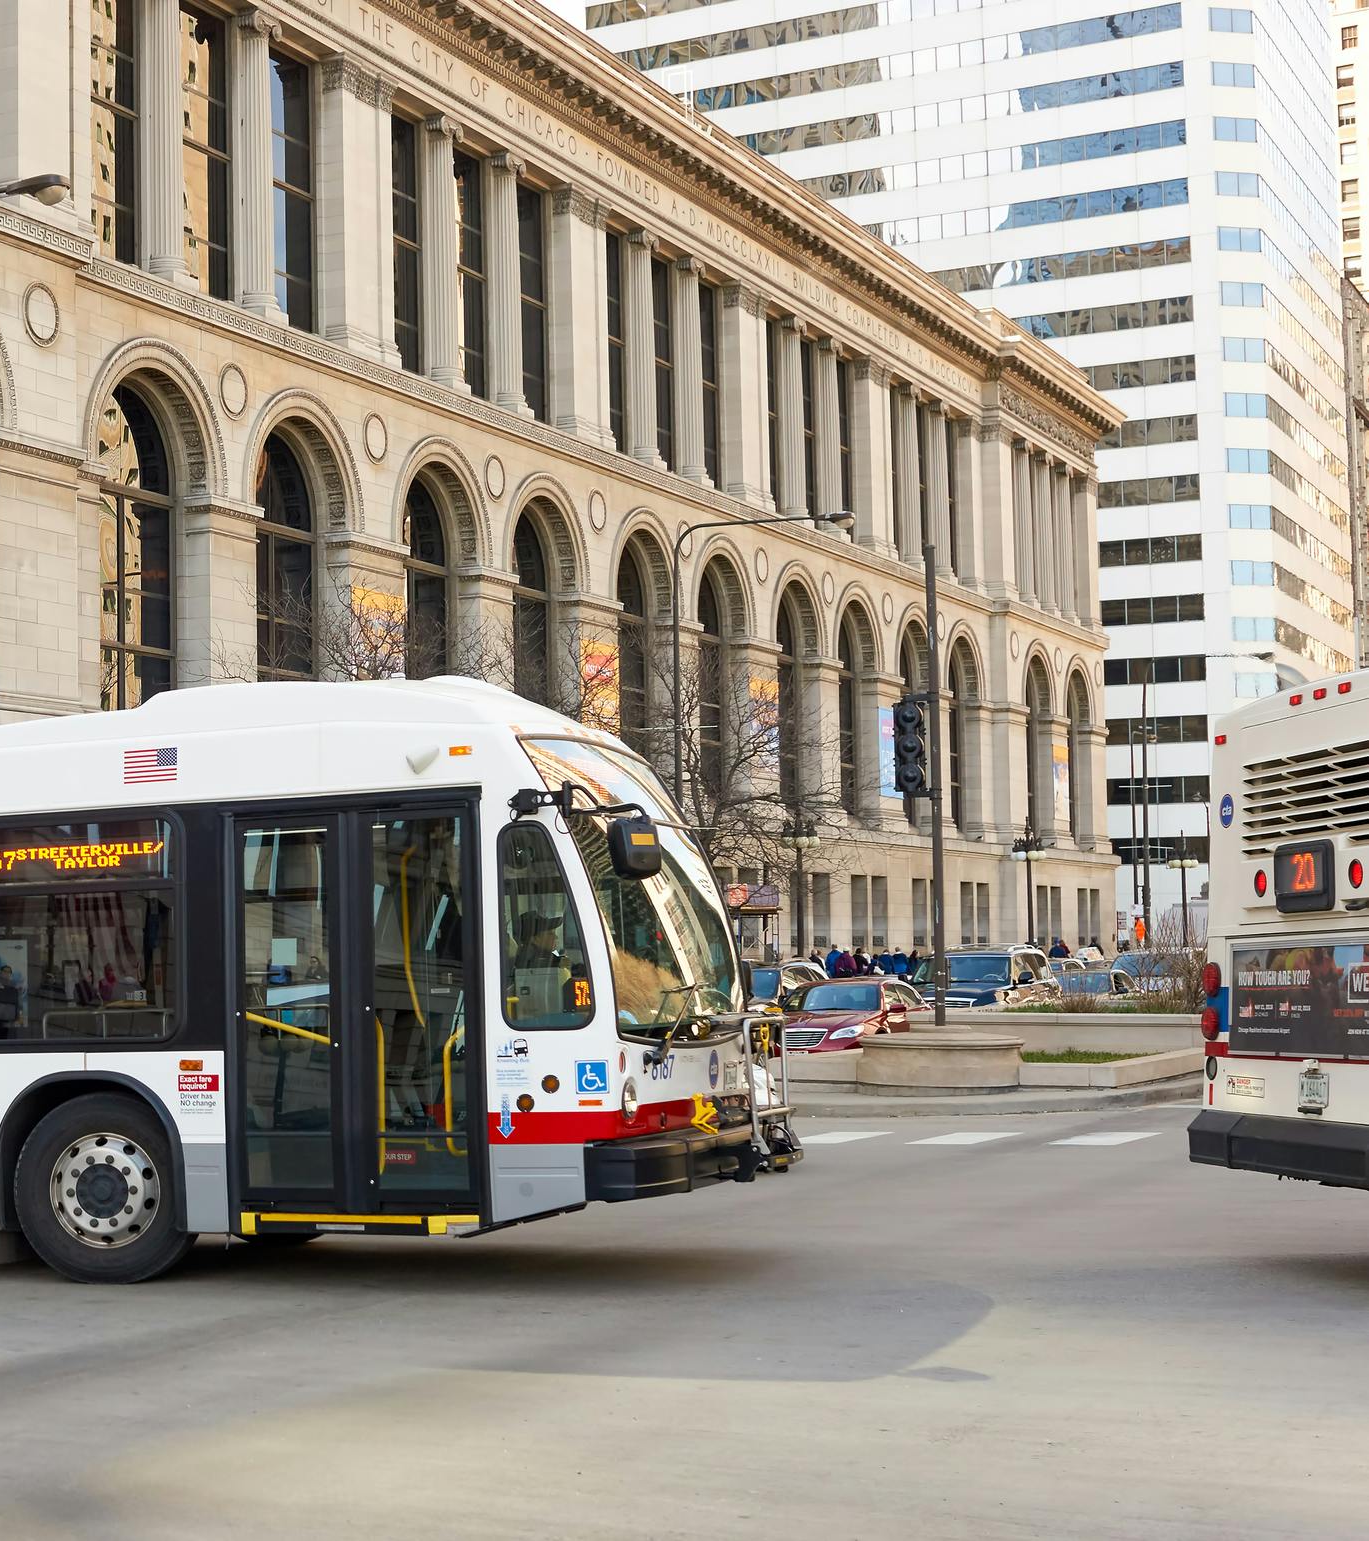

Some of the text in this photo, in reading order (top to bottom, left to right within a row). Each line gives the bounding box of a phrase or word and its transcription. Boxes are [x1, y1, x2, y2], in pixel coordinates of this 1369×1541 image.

[358, 7, 395, 49] THE
[411, 40, 454, 83] CITY
[469, 76, 490, 102] OF
[505, 97, 578, 156] CHICAGO
[596, 151, 660, 205] FOVNDED
[845, 305, 900, 351] COMPLETED
[1222, 805, 1232, 817] cta
[53, 855, 120, 870] TAYLOR
[1292, 852, 1316, 892] 20
[1238, 969, 1311, 986] HOW TOUGH ARE YOU?
[179, 1075, 213, 1083] Exact fare
[179, 1083, 208, 1091] required
[192, 1099, 217, 1107] change
[396, 1153, 412, 1161] STEP
